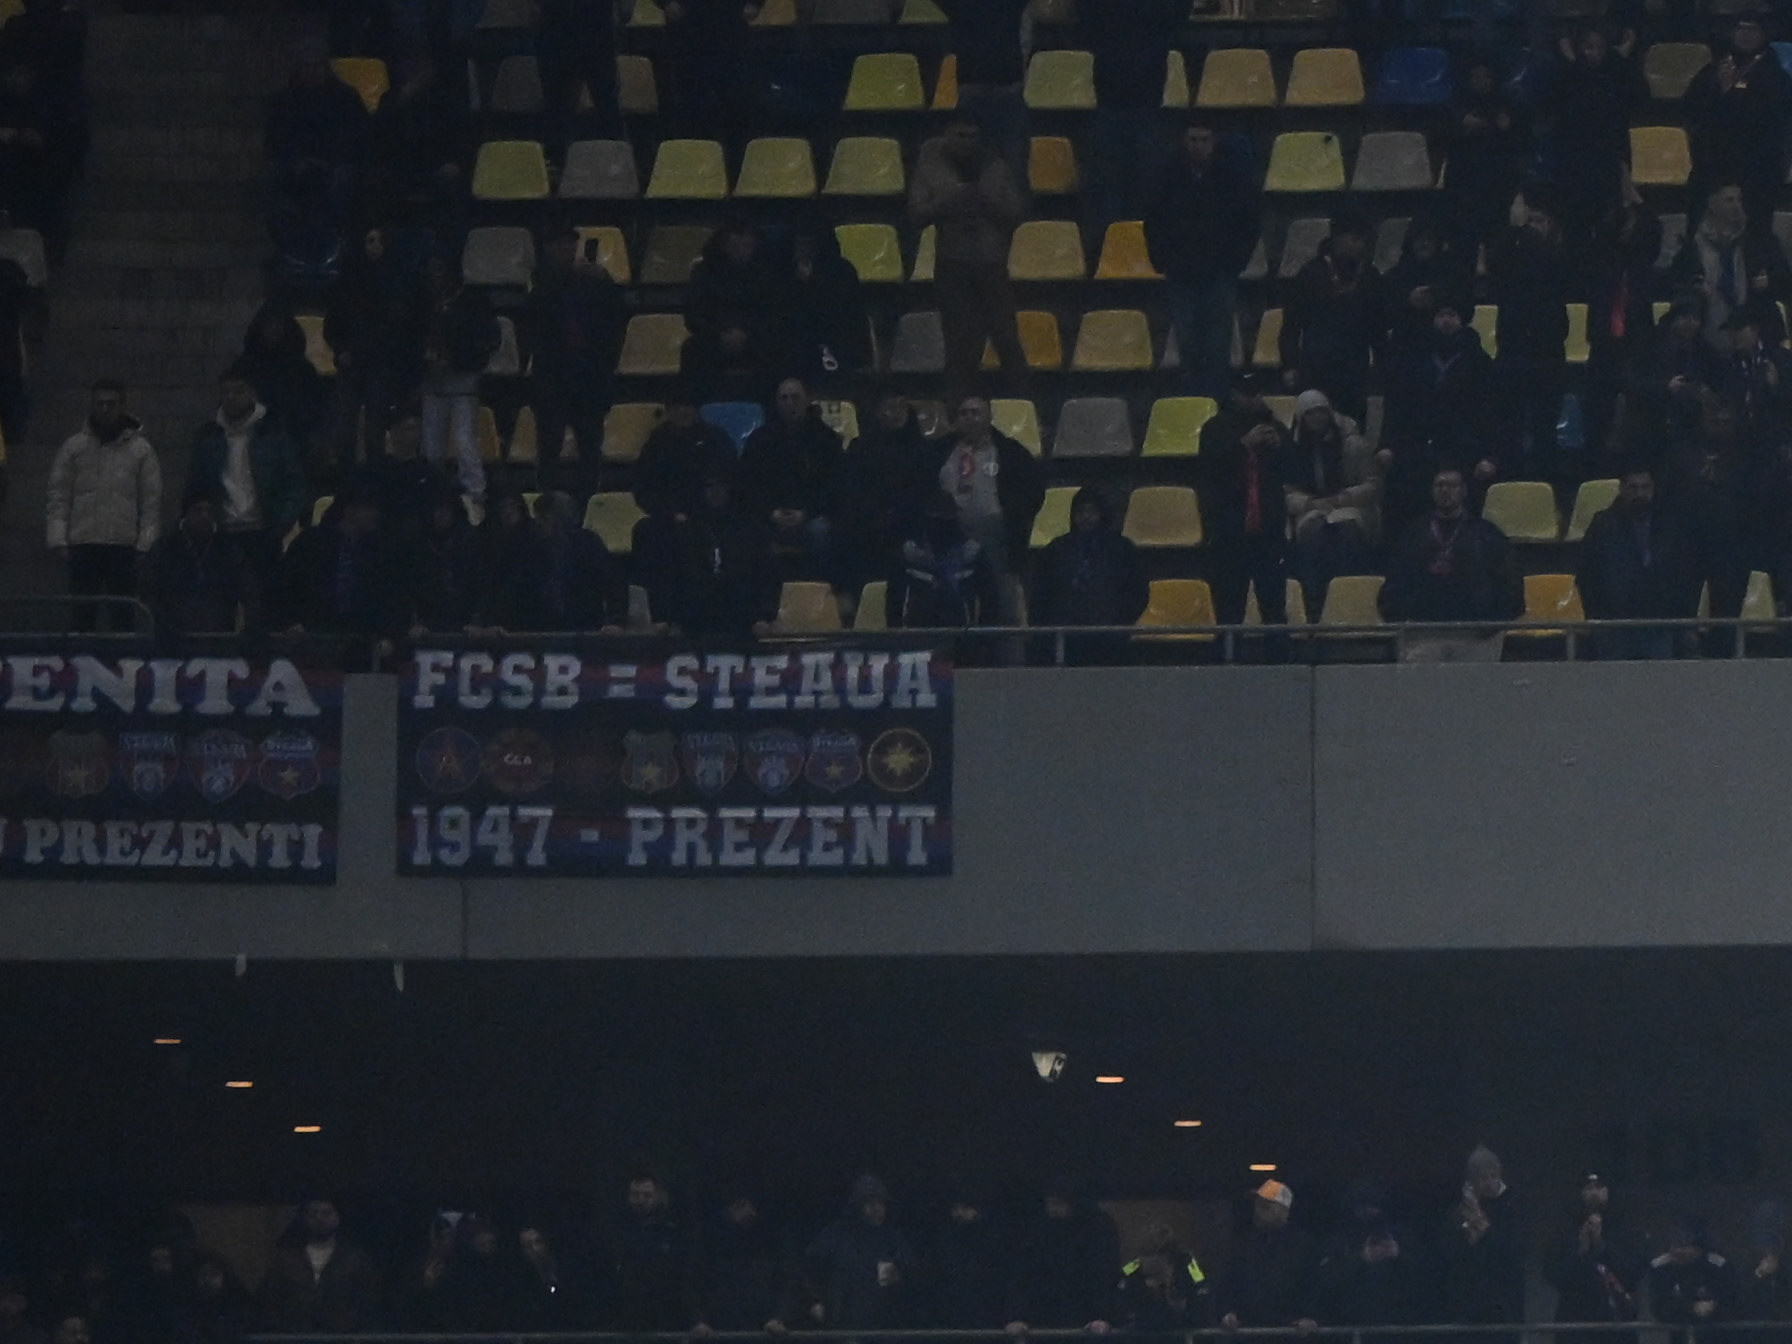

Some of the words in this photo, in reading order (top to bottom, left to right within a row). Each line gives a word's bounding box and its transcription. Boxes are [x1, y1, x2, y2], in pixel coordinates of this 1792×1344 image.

[412, 651, 582, 710] FCSB
[662, 650, 938, 709] STEAUA
[22, 818, 324, 868] PREZENTI
[411, 806, 555, 866] 1947
[625, 805, 937, 866] PREZENT
